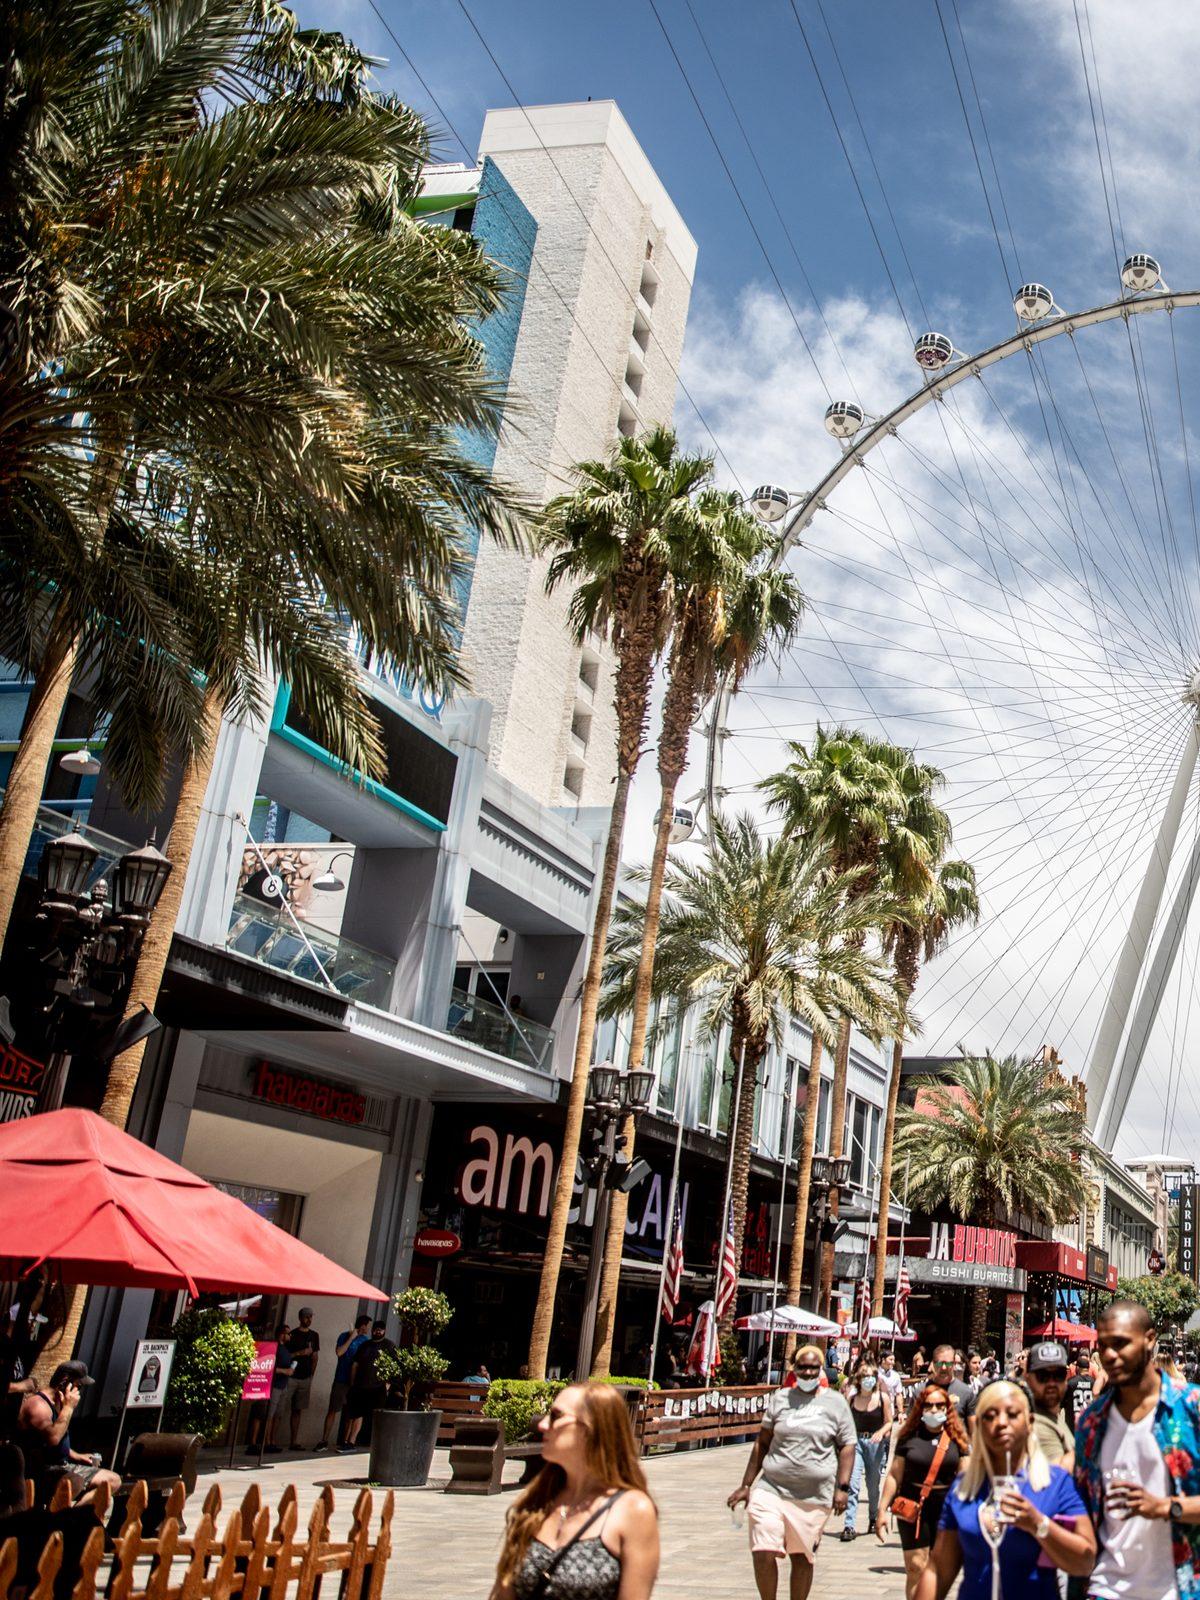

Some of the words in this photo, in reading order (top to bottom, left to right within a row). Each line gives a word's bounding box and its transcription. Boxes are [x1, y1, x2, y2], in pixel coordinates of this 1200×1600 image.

[255, 1060, 367, 1125] havaianas
[1184, 1186, 1192, 1232] YARD
[417, 1237, 455, 1248] havaianas
[932, 1265, 969, 1279] SUSHI
[973, 1269, 1014, 1284] BURRITOS
[260, 1359, 273, 1370] off
